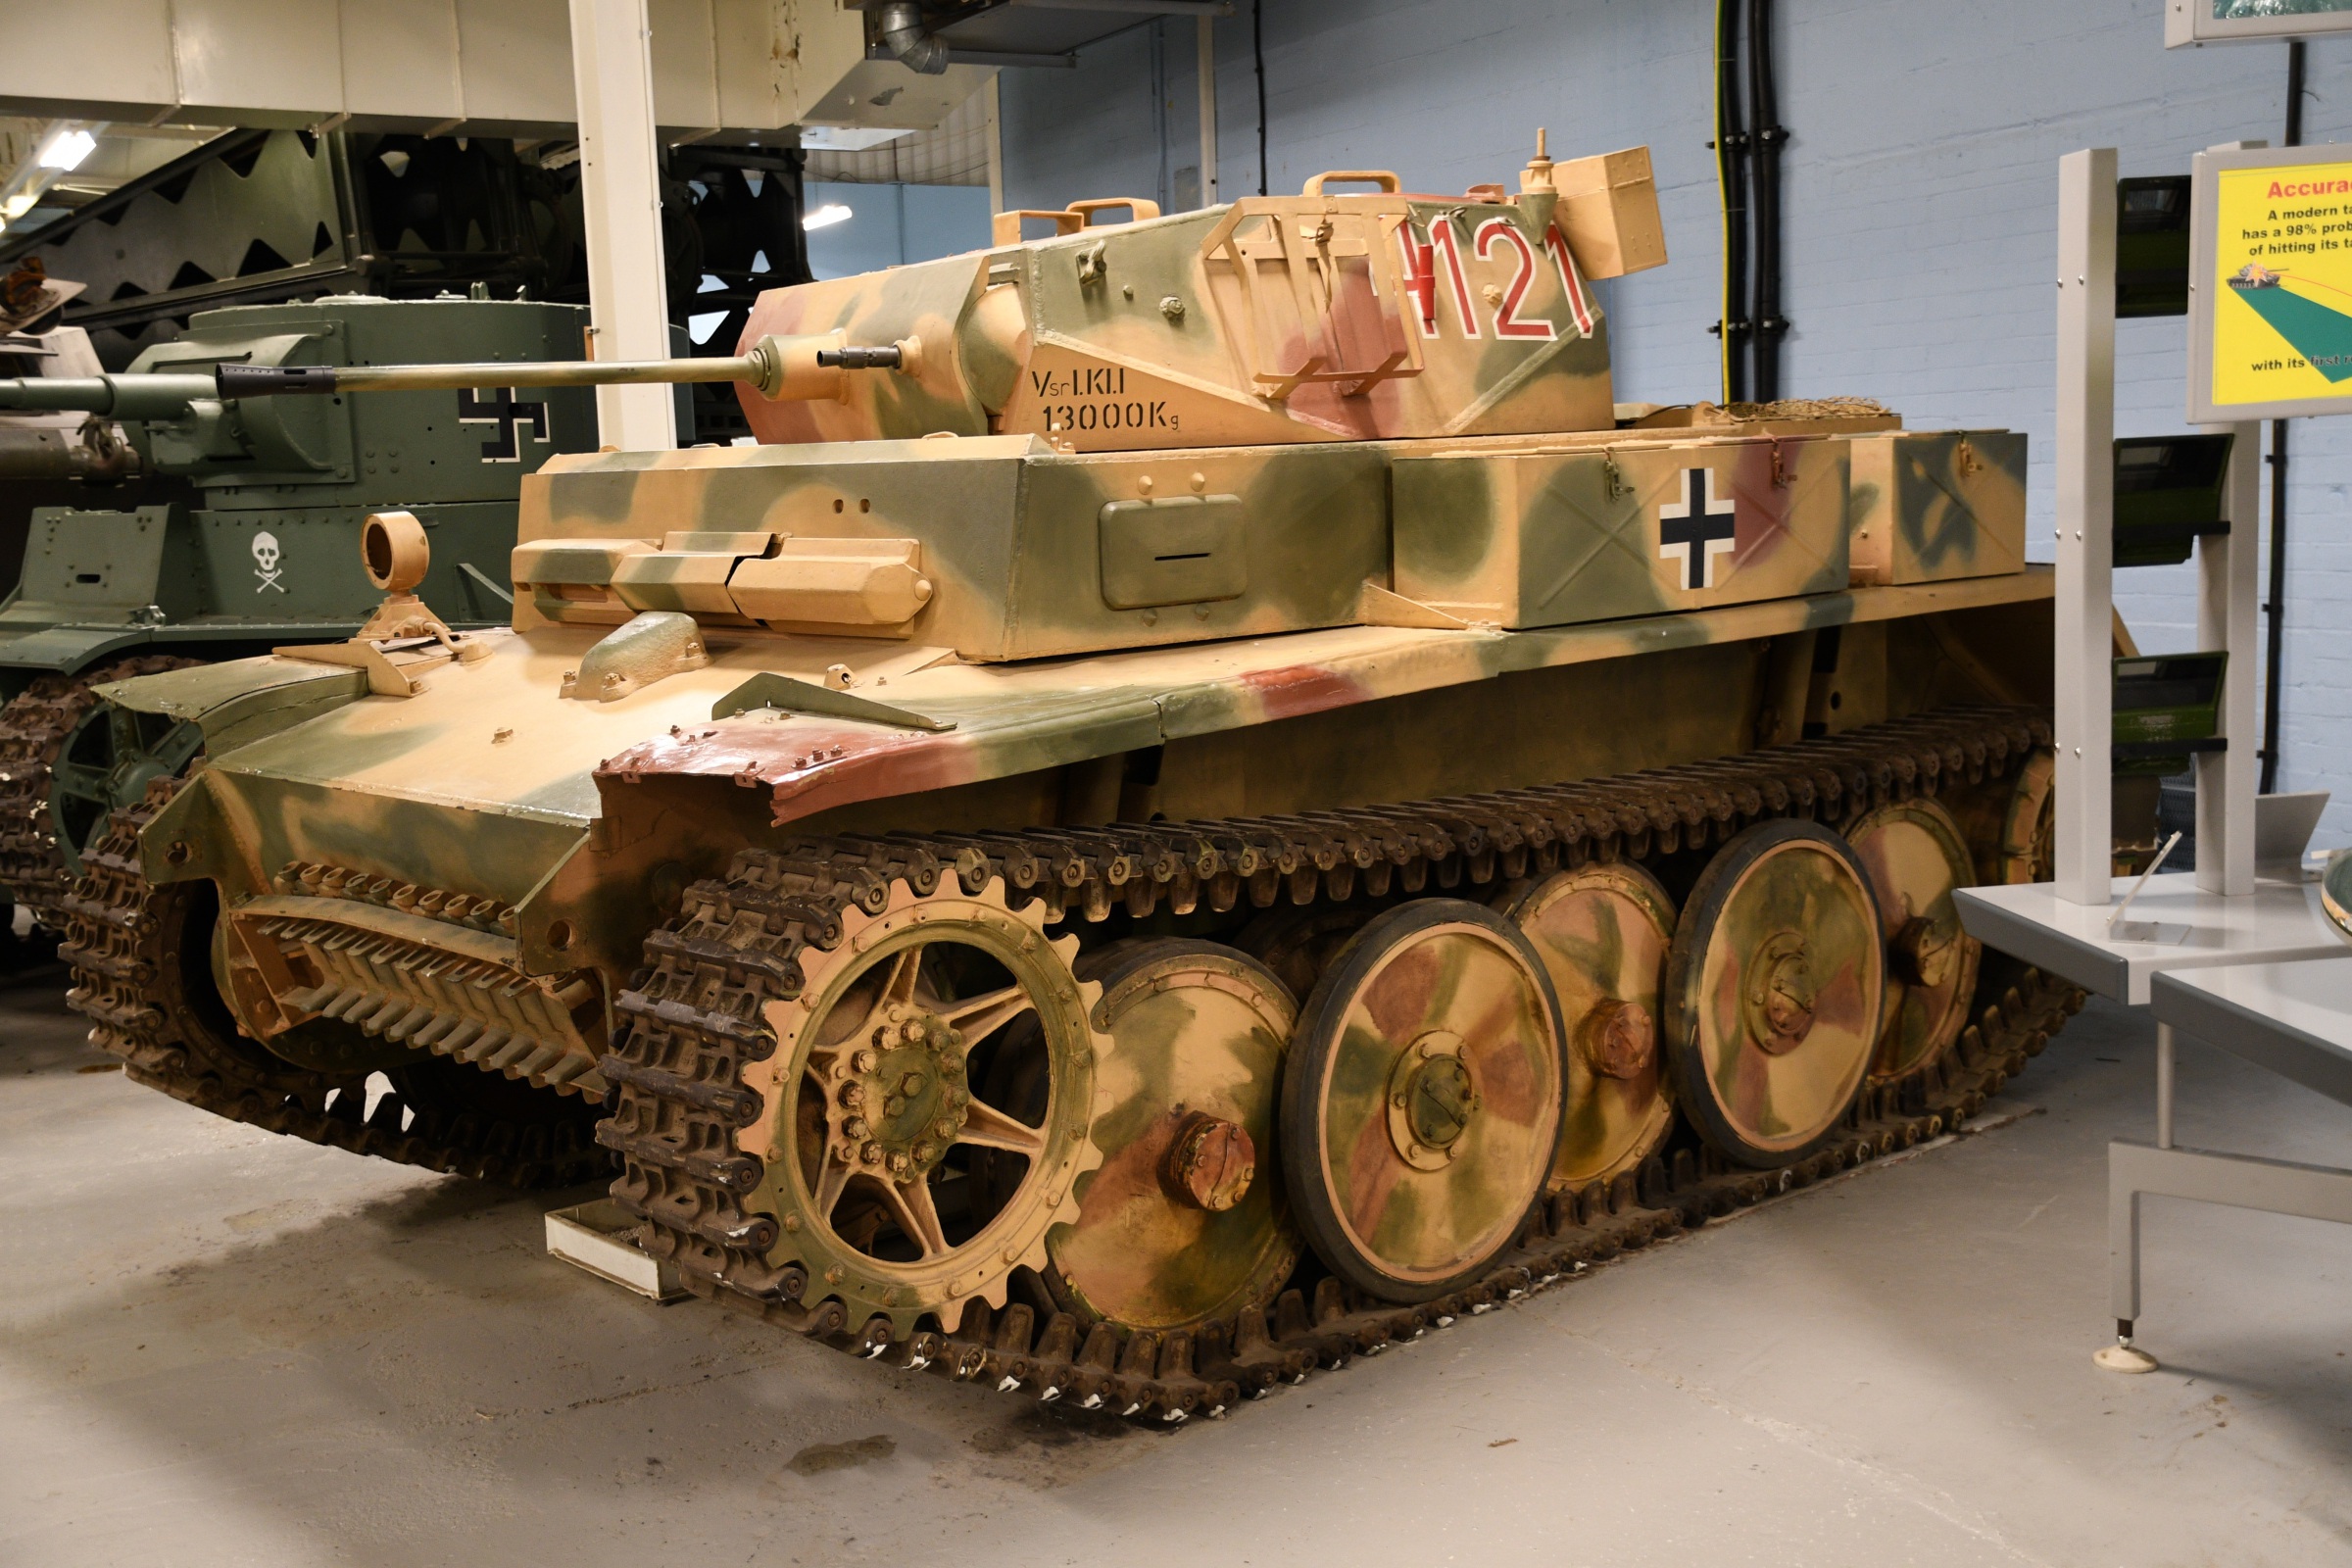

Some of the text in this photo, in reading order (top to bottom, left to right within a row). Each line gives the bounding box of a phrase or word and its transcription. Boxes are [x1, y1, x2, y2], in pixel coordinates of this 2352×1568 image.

[2267, 179, 2352, 199] Accura
[2268, 210, 2278, 221] A
[2282, 207, 2338, 220] modern
[2242, 229, 2268, 240] has
[2273, 228, 2281, 237] a
[2286, 223, 2317, 236] 98%
[2249, 244, 2263, 256] of
[2269, 241, 2316, 255] hitting
[2321, 239, 2339, 251] its
[2251, 360, 2282, 371] with
[2287, 358, 2305, 368] its
[2310, 355, 2340, 367] first
